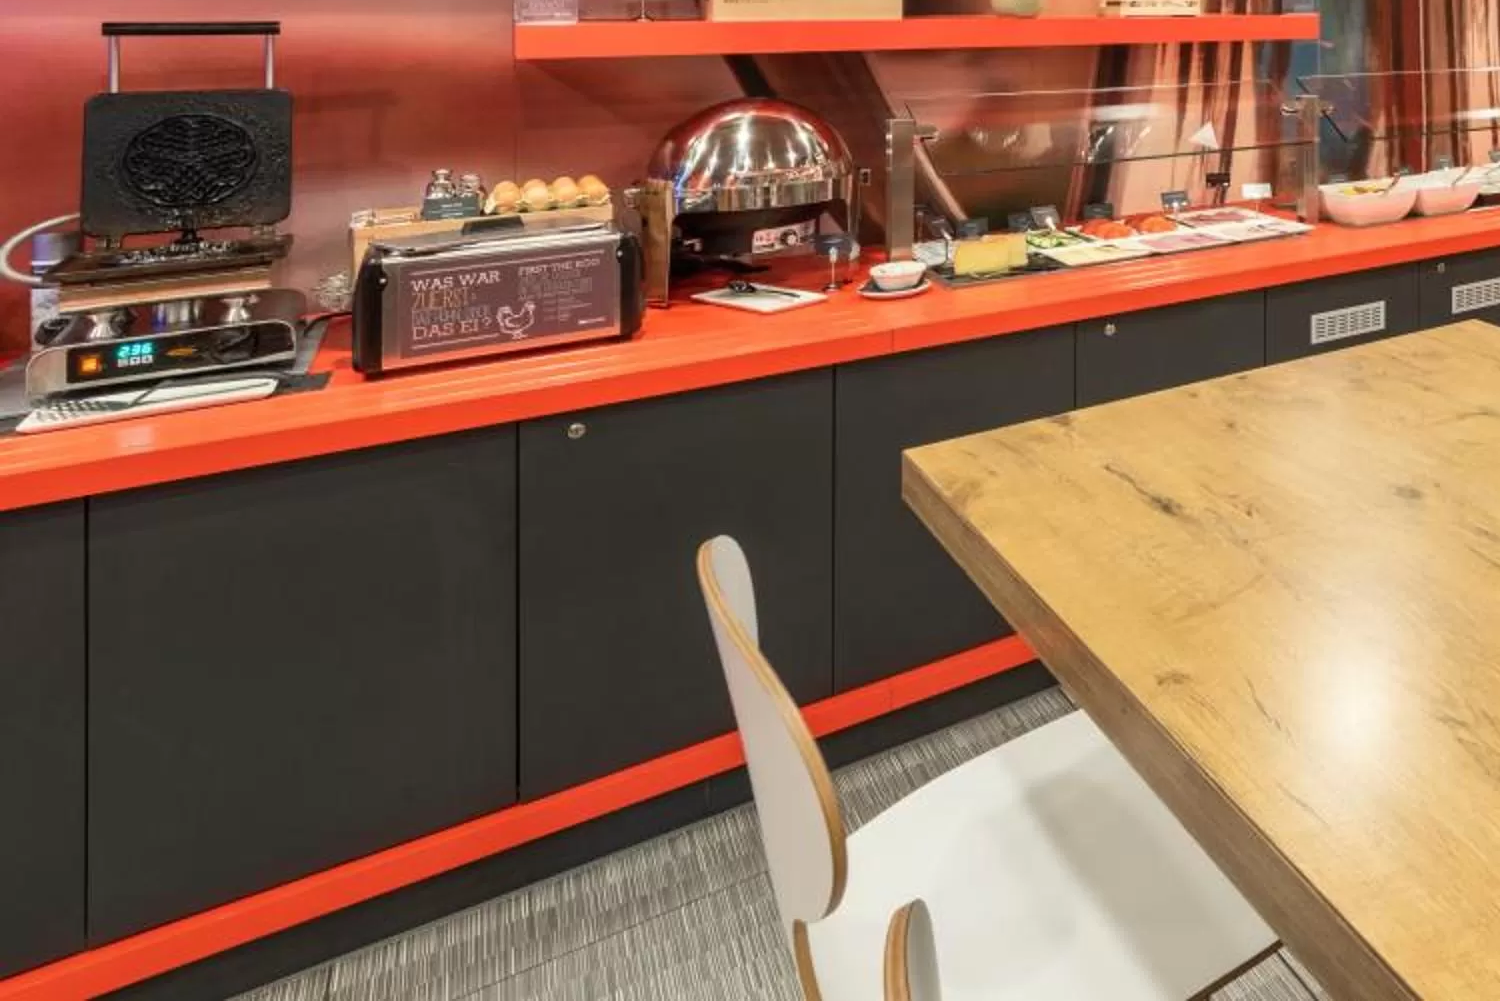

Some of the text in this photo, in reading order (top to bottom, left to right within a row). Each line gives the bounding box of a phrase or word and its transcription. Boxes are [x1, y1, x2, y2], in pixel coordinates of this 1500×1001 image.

[410, 270, 500, 292] WAS WAR
[412, 322, 455, 340] DAS
